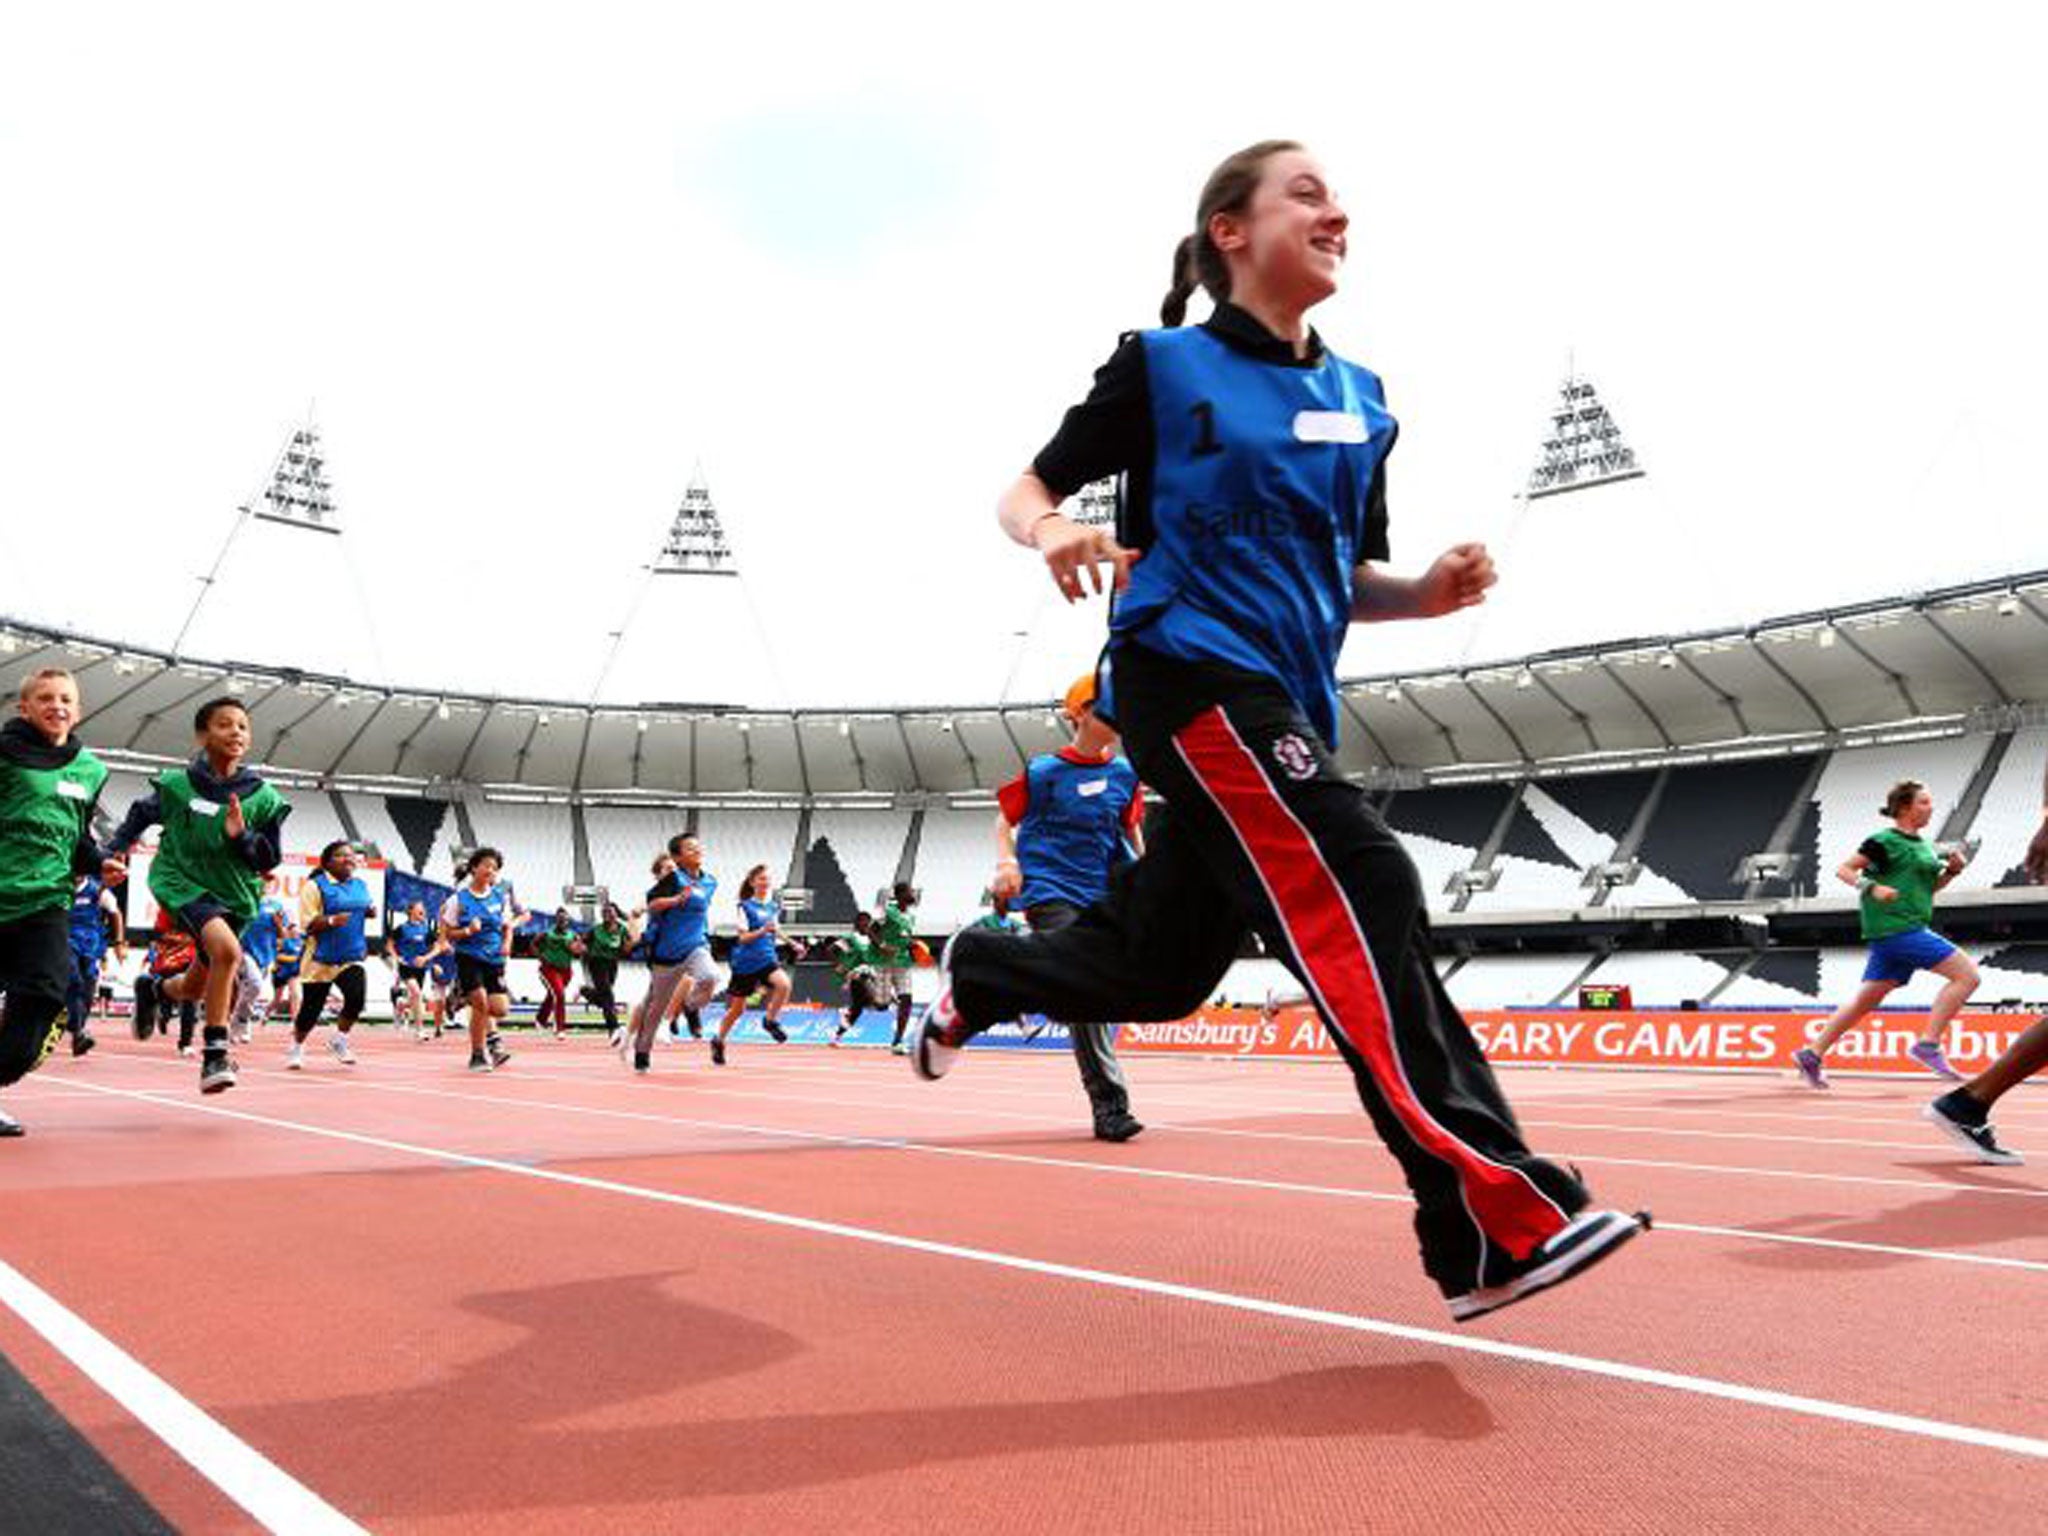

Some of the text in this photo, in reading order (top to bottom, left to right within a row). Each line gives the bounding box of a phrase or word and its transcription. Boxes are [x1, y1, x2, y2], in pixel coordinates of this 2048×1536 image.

[1188, 400, 1223, 454] 1
[1125, 1018, 1278, 1053] Sainsbury's
[1471, 1022, 1585, 1054] SARY
[1594, 1023, 1776, 1059] GAMES
[1803, 1018, 2022, 1060] Sainbu
